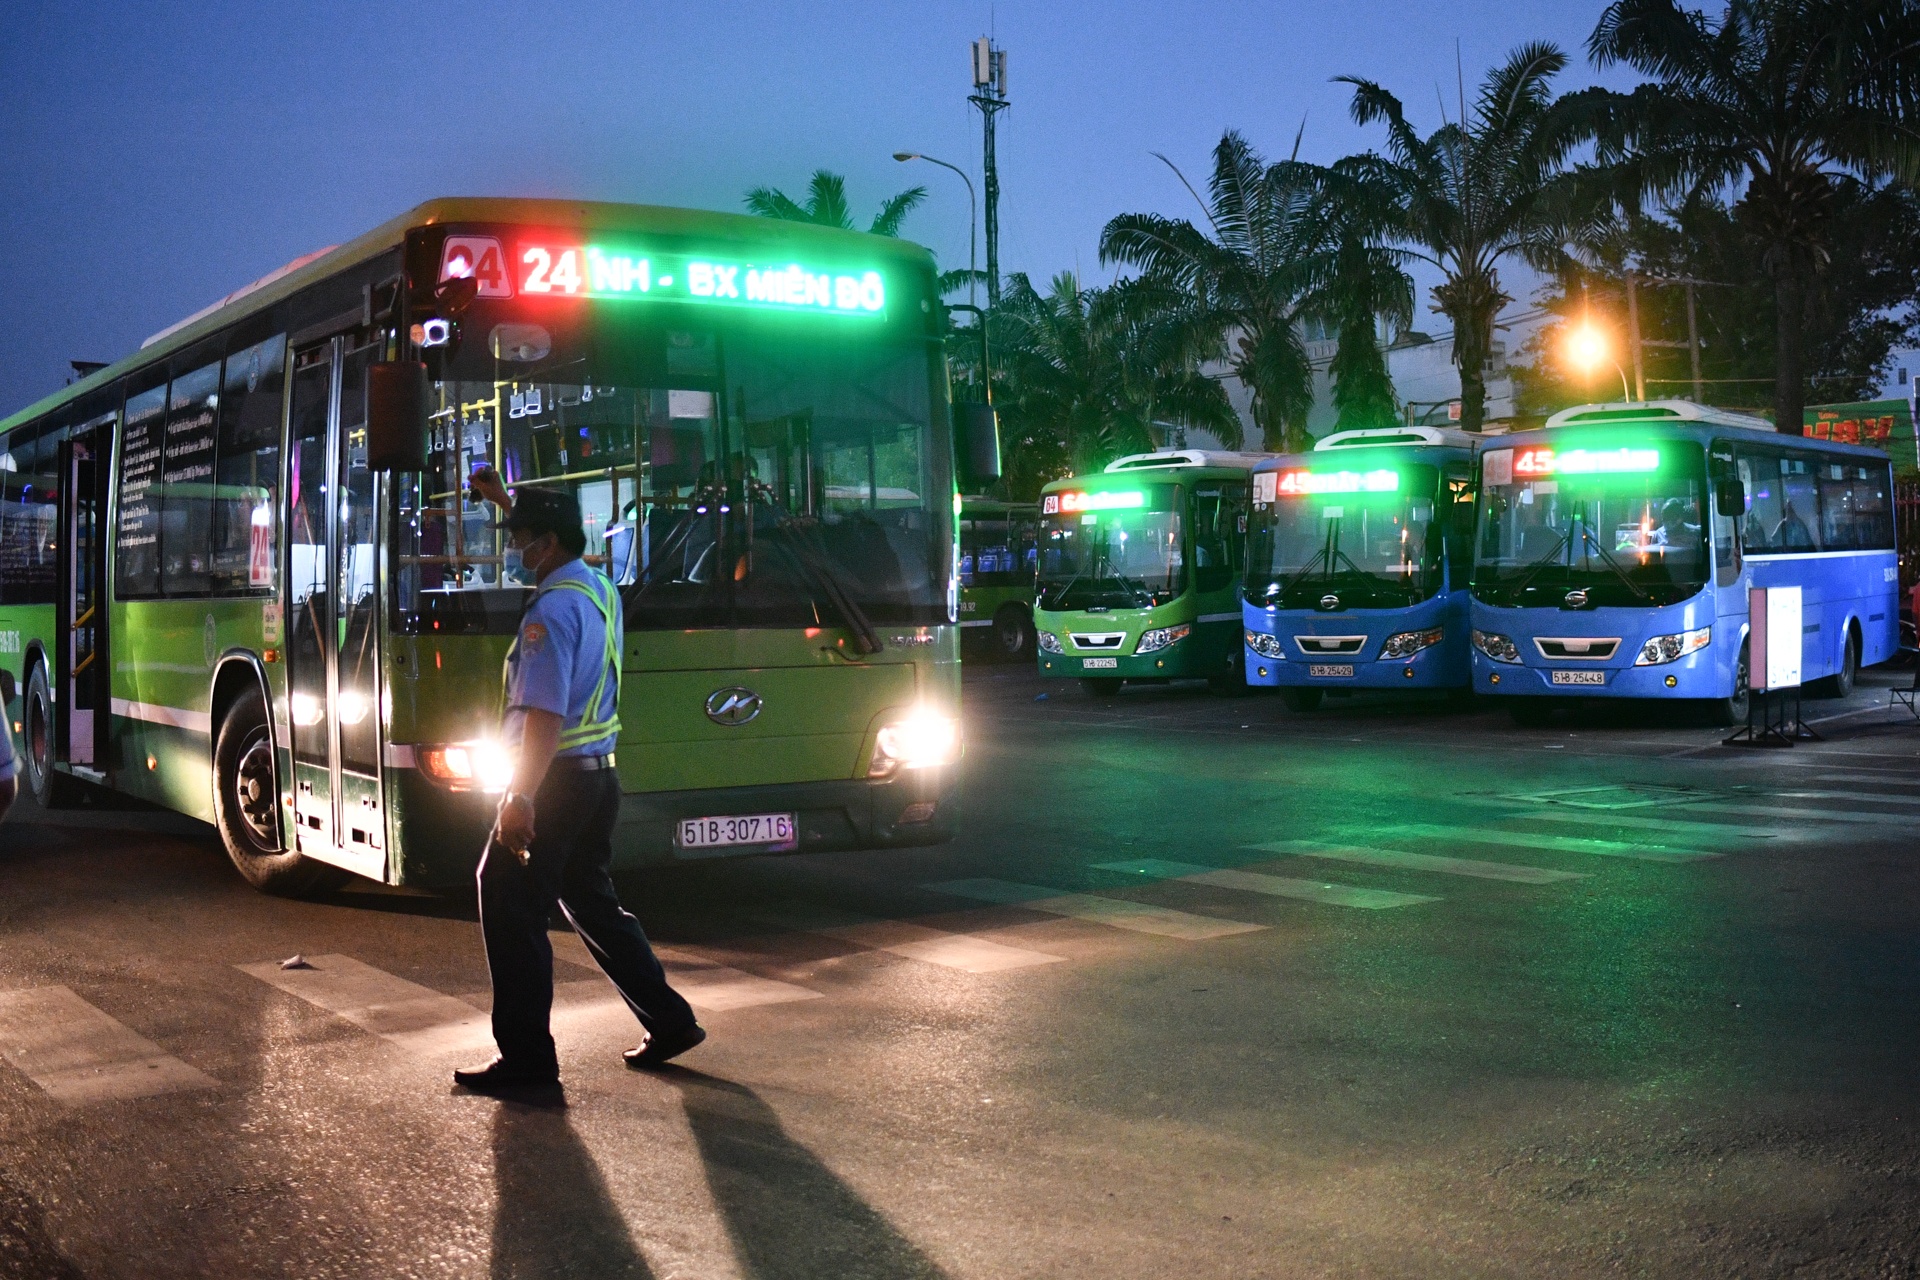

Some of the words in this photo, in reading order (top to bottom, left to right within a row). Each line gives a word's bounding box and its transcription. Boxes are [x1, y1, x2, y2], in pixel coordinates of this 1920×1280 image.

[523, 247, 582, 294] 24
[590, 249, 649, 292] NH
[689, 261, 739, 299] BX
[1516, 450, 1553, 472] 45
[1280, 471, 1311, 493] 45
[1045, 497, 1056, 512] 64
[252, 524, 268, 580] 24
[685, 817, 787, 844] 51B-307.16
